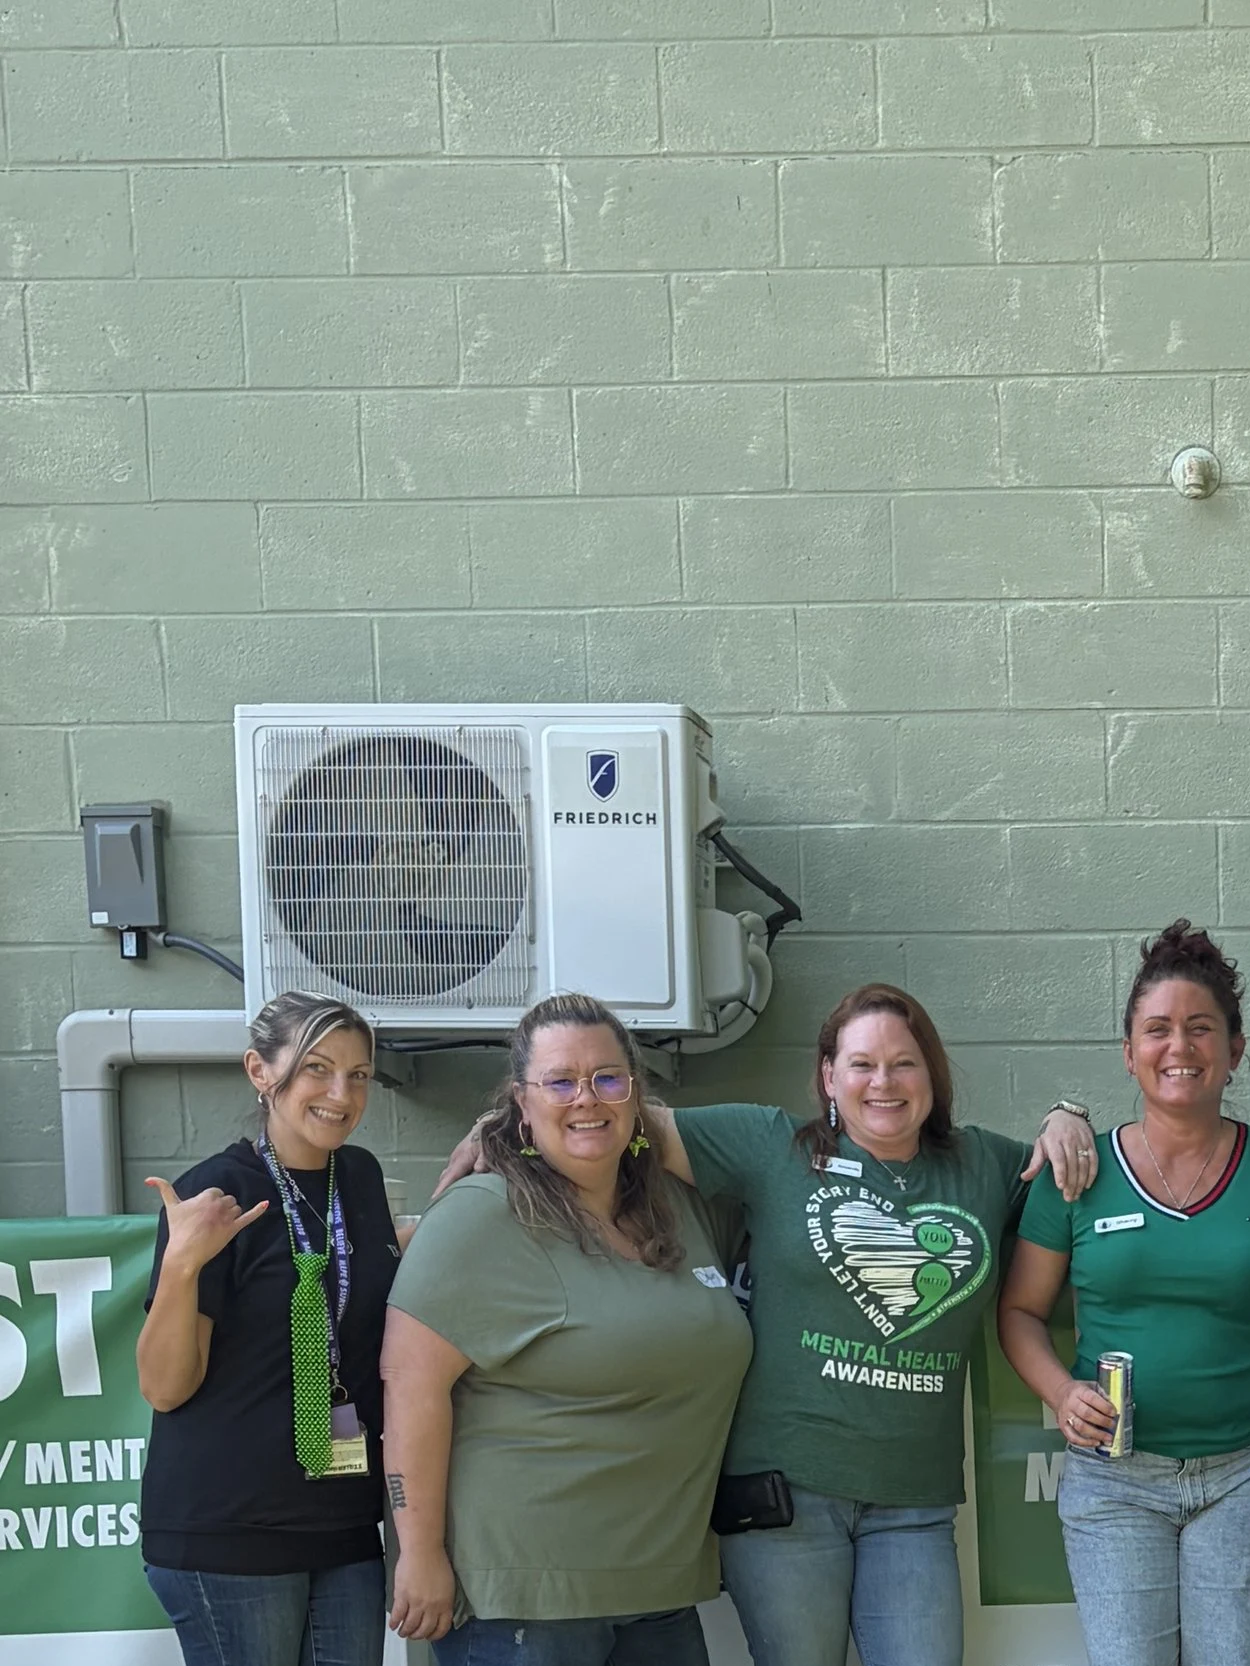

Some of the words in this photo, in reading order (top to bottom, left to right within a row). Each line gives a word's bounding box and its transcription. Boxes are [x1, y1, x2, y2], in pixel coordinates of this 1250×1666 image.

[553, 811, 657, 825] FRIEDRICH
[805, 1185, 850, 1214] STORY
[859, 1187, 895, 1213] END
[807, 1217, 833, 1264] YOUR
[923, 1231, 948, 1244] YOU
[829, 1264, 859, 1293] LET
[853, 1293, 895, 1337] DON'T
[801, 1330, 891, 1366] MENTAL
[897, 1350, 962, 1371] HEALTH
[821, 1359, 944, 1393] AWARENESS
